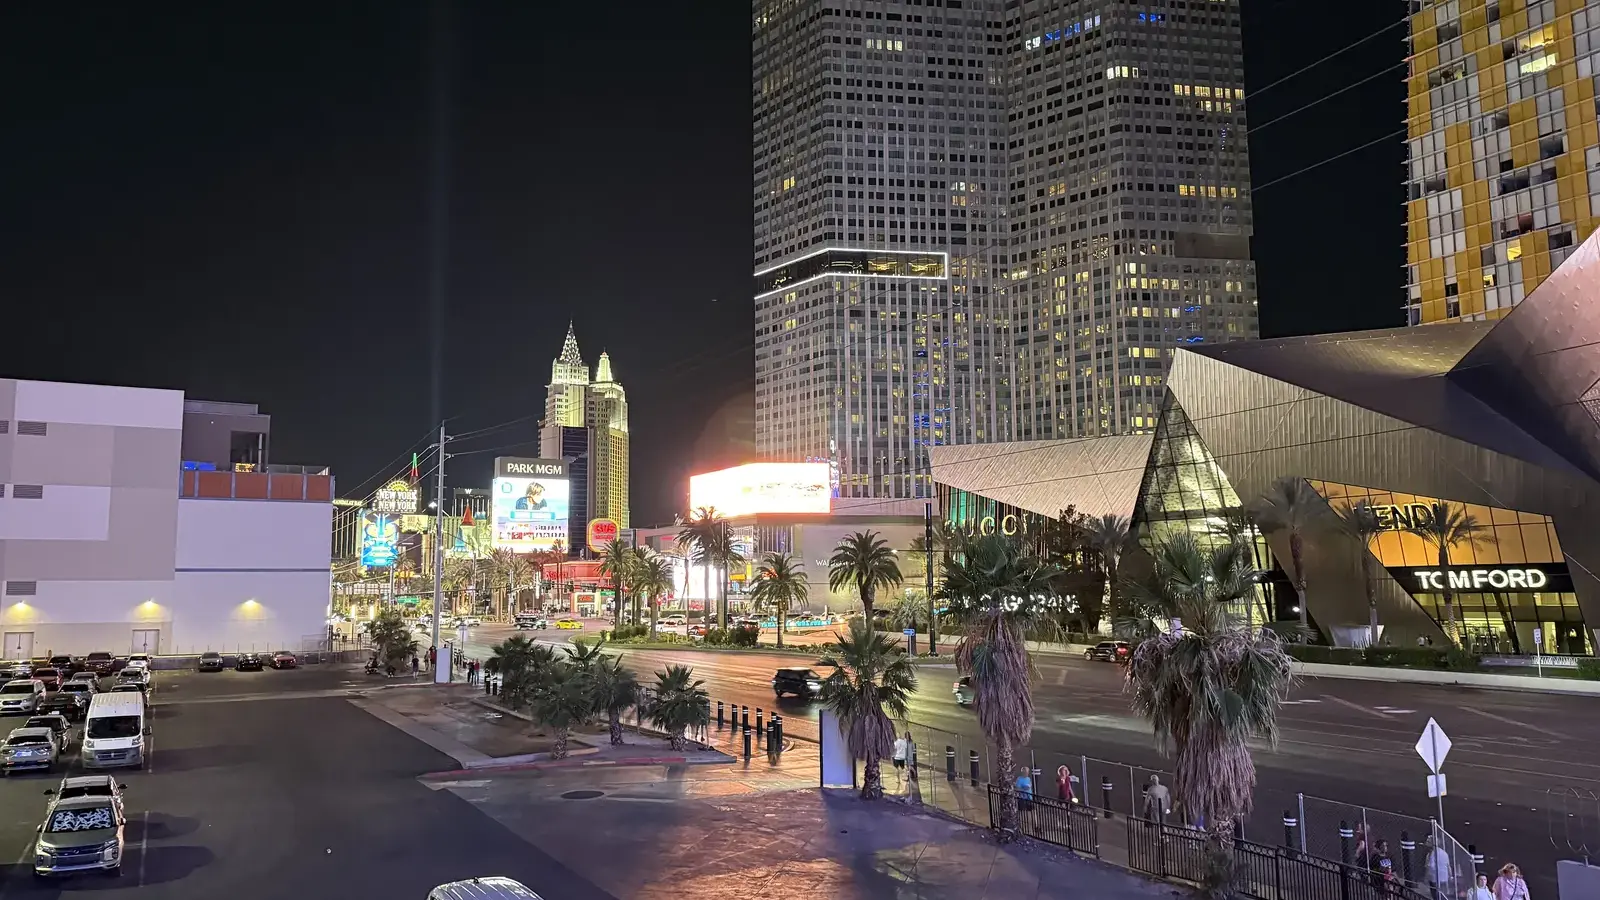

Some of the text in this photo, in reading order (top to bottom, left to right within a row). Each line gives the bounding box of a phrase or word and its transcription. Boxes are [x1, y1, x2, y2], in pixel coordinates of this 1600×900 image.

[507, 463, 562, 475] PARK MGM
[379, 489, 417, 499] NEW YORK
[378, 500, 417, 509] NEW YORK
[1353, 502, 1441, 531] END
[1414, 569, 1546, 589] TOM FORD
